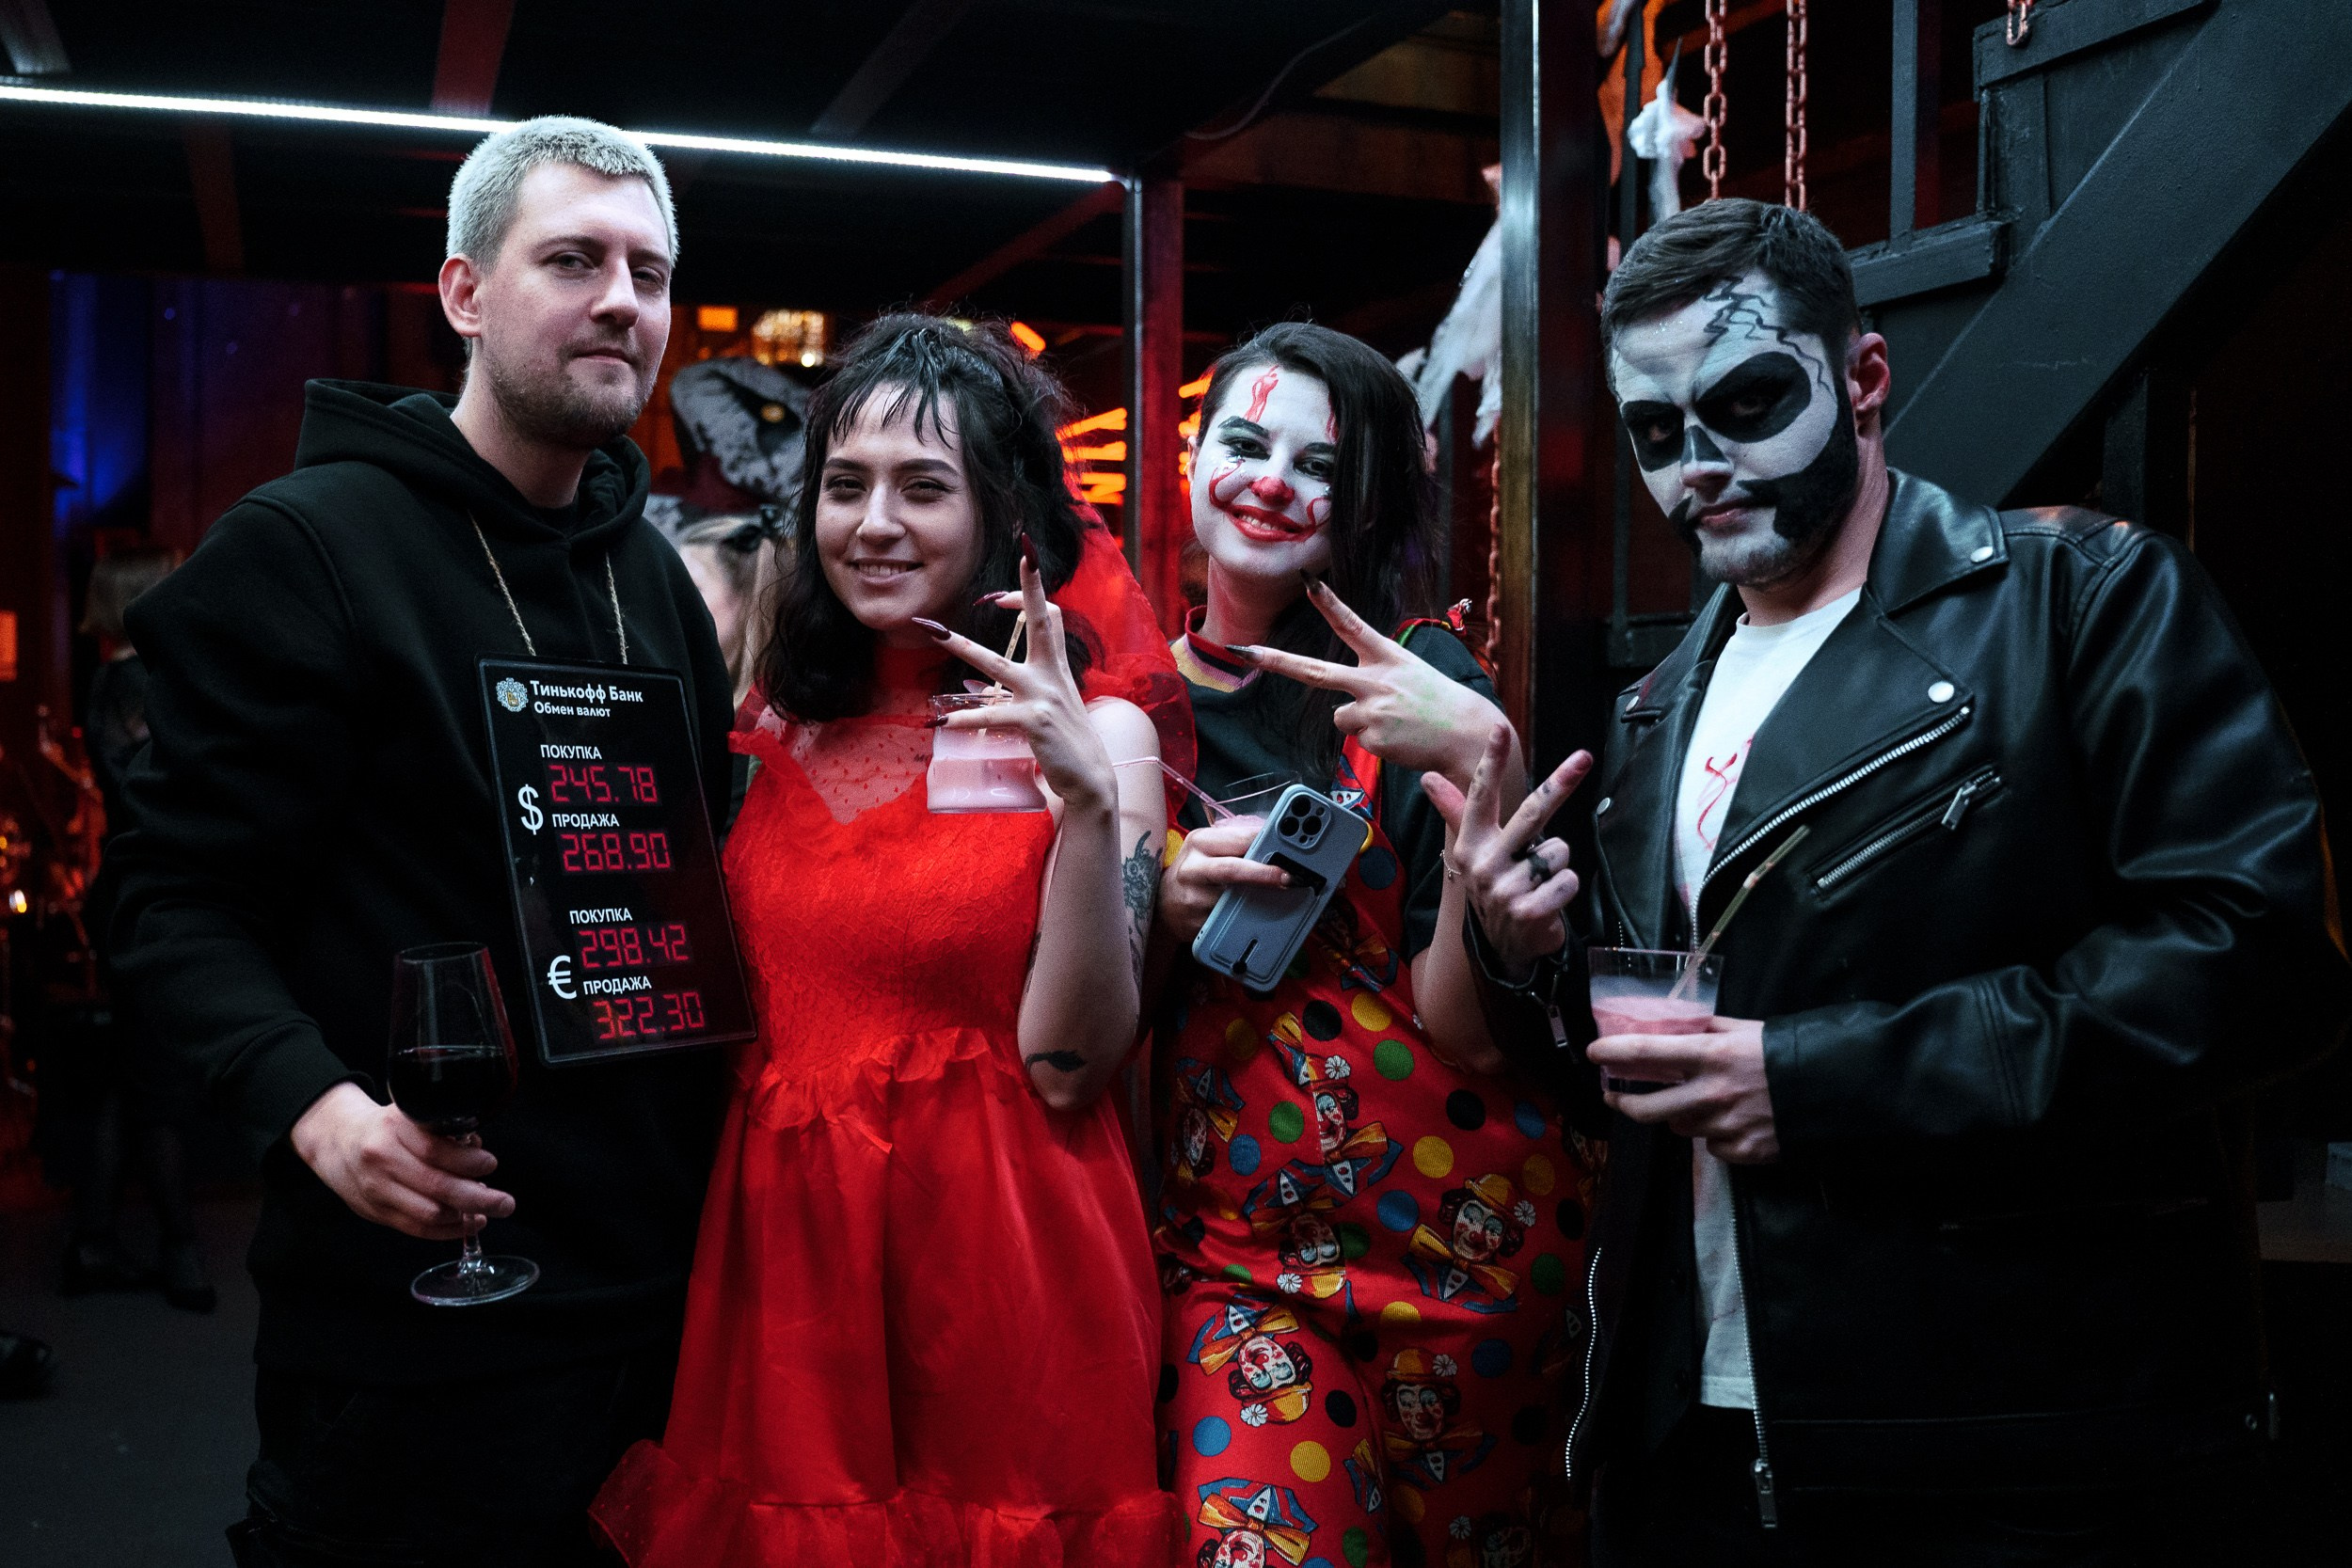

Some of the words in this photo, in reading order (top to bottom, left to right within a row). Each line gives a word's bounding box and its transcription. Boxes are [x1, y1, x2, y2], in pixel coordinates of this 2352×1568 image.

[529, 679, 607, 705] Тинькофф
[608, 685, 644, 703] Банк
[533, 701, 575, 716] Обмен
[576, 706, 611, 718] валют
[540, 744, 603, 760] ПОКУПКА
[549, 765, 658, 802] 245.78
[517, 784, 544, 836] $
[551, 813, 620, 830] ПРОДАЖА
[561, 832, 671, 872] 268.90
[569, 907, 633, 926] ПОКУПКА
[579, 925, 689, 969] 298.42
[547, 955, 578, 1000] €
[582, 975, 652, 995] ПРОДАЖА
[593, 991, 704, 1039] 322.30
